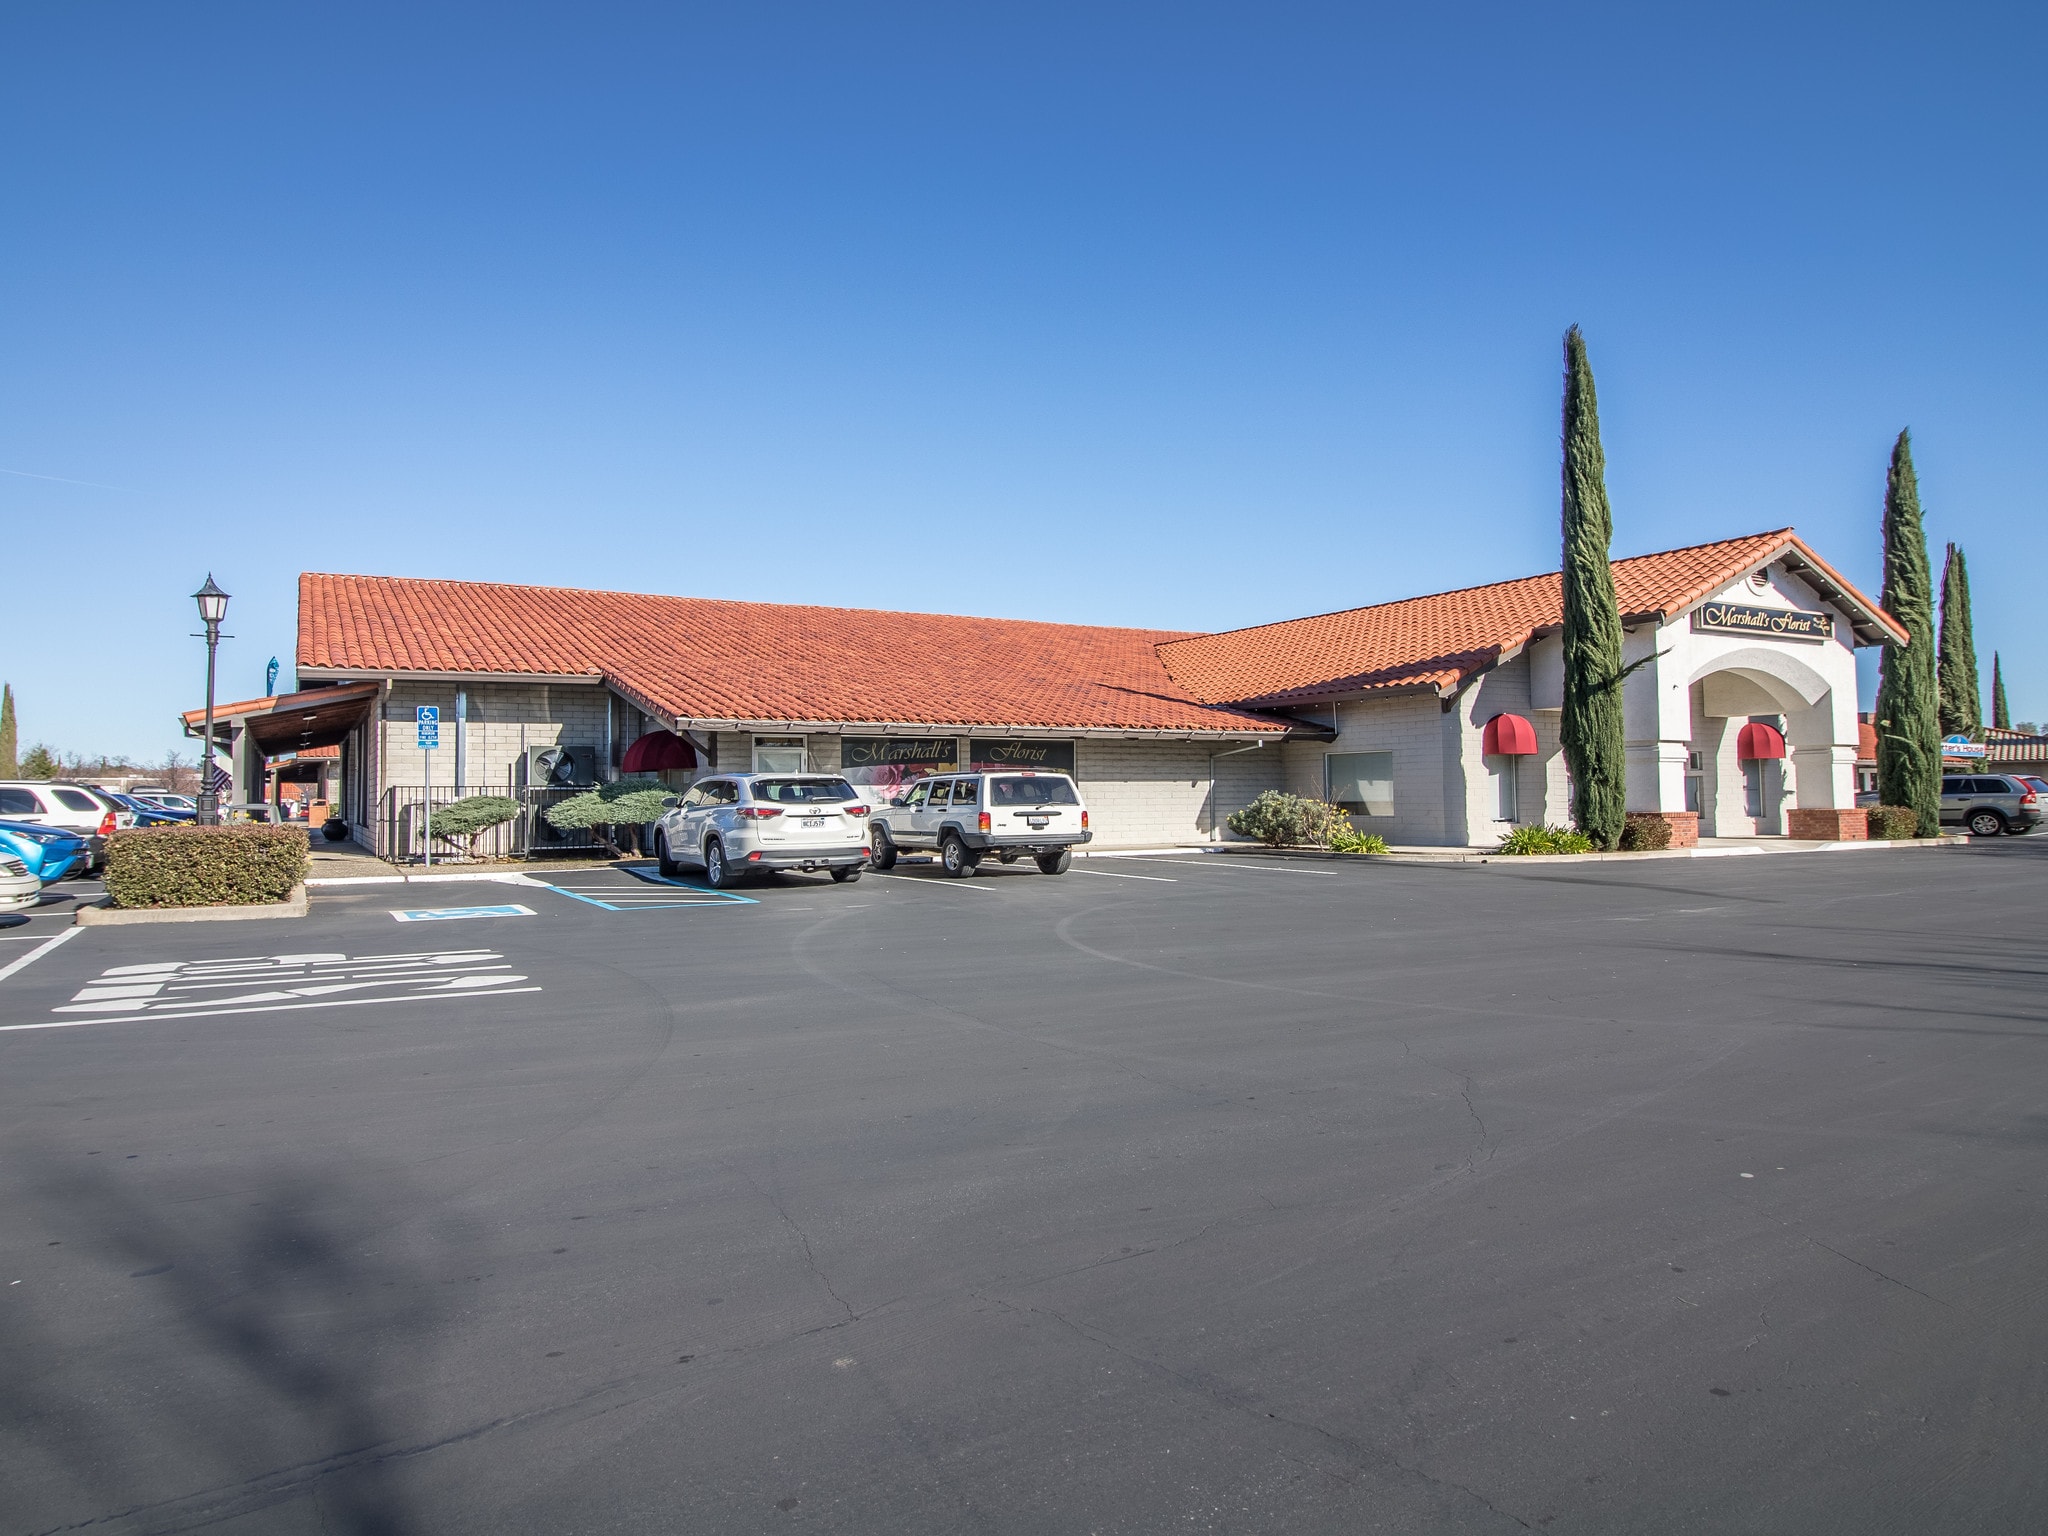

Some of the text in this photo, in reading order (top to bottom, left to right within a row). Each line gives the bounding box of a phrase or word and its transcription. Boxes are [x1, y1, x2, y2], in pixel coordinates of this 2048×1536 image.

[1706, 605, 1811, 632] Marshall's Florist
[851, 740, 1047, 762] Marshall's Florist
[1962, 745, 1984, 753] House
